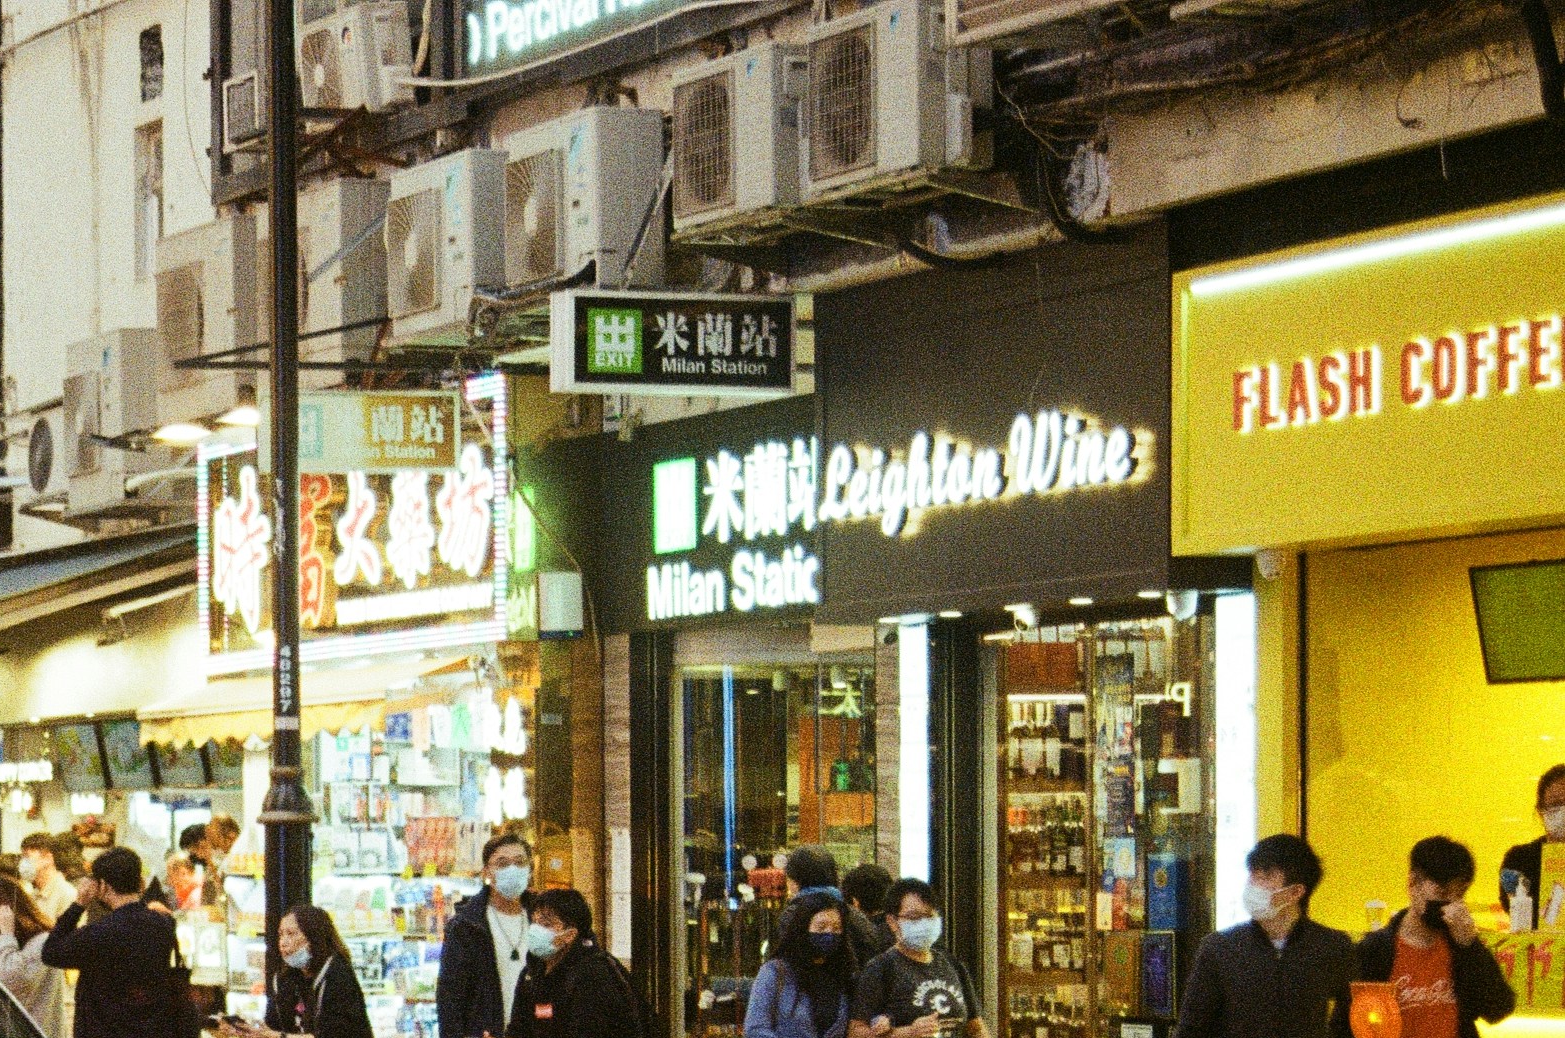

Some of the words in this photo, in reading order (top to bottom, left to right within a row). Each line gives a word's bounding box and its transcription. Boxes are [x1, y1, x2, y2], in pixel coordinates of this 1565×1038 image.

[594, 352, 637, 369] EXIT
[652, 310, 778, 359] 米蘭站
[661, 357, 706, 374] Milan
[710, 359, 769, 375] Station
[1231, 345, 1381, 435] FLASH
[1399, 312, 1565, 409] COFFE
[820, 429, 1004, 538] Leighton
[1007, 408, 1133, 494] Wine
[646, 560, 727, 622] Milan
